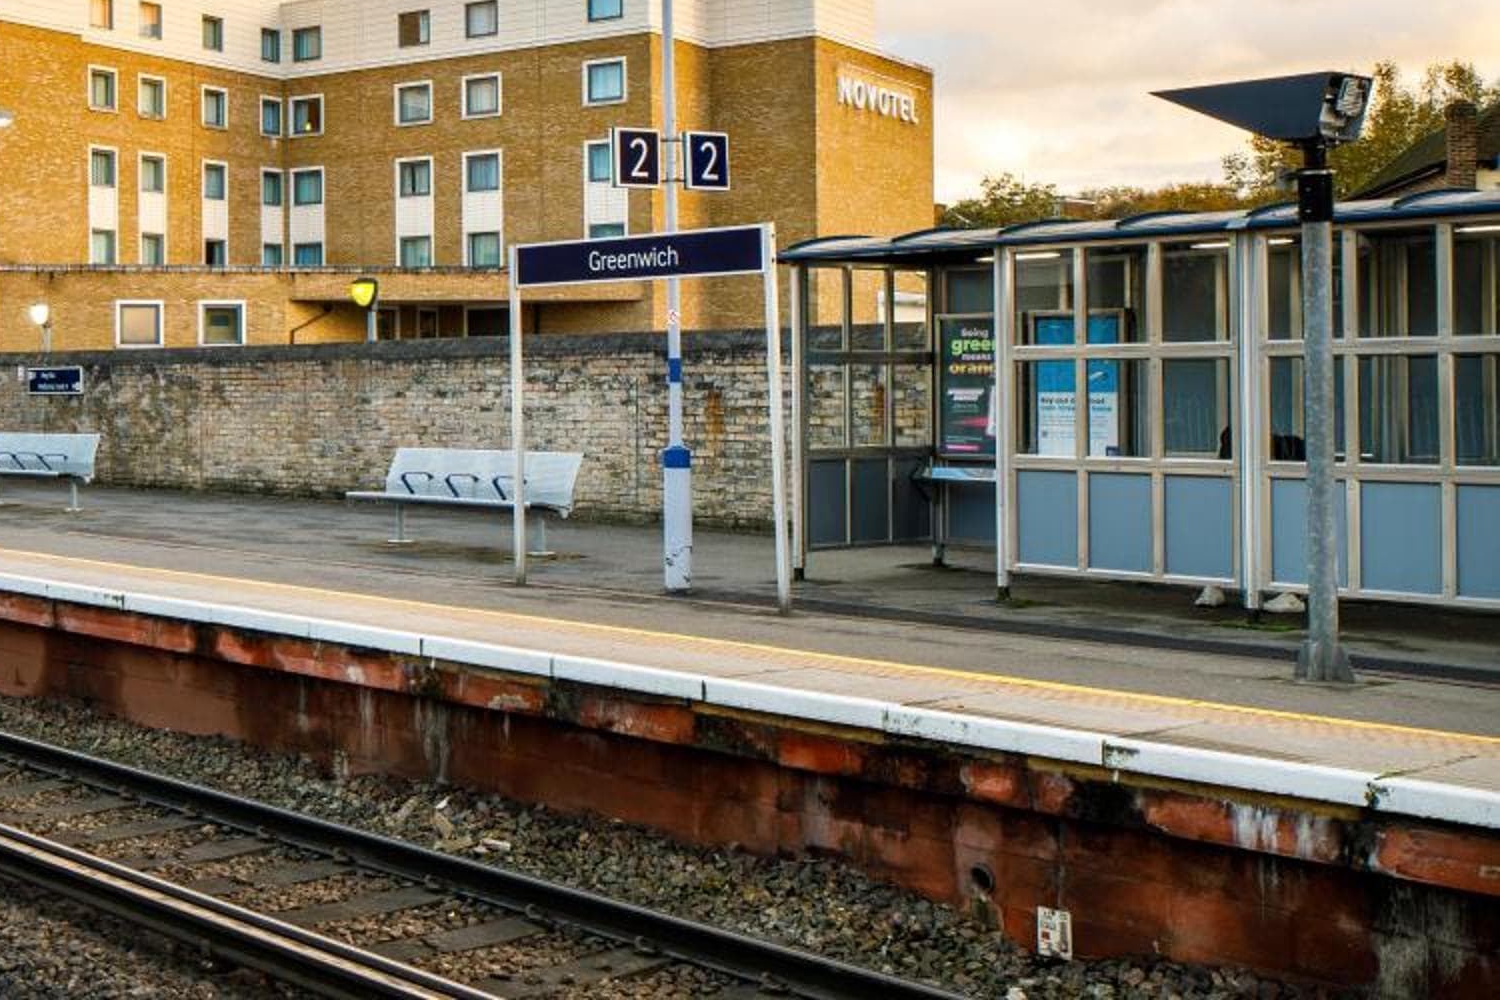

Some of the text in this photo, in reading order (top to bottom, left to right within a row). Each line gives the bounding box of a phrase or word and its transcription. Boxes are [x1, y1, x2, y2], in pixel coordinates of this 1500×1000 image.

[836, 75, 920, 125] NOVOTEL
[629, 137, 649, 178] 2
[700, 141, 720, 181] 2
[588, 245, 680, 272] Greenwich
